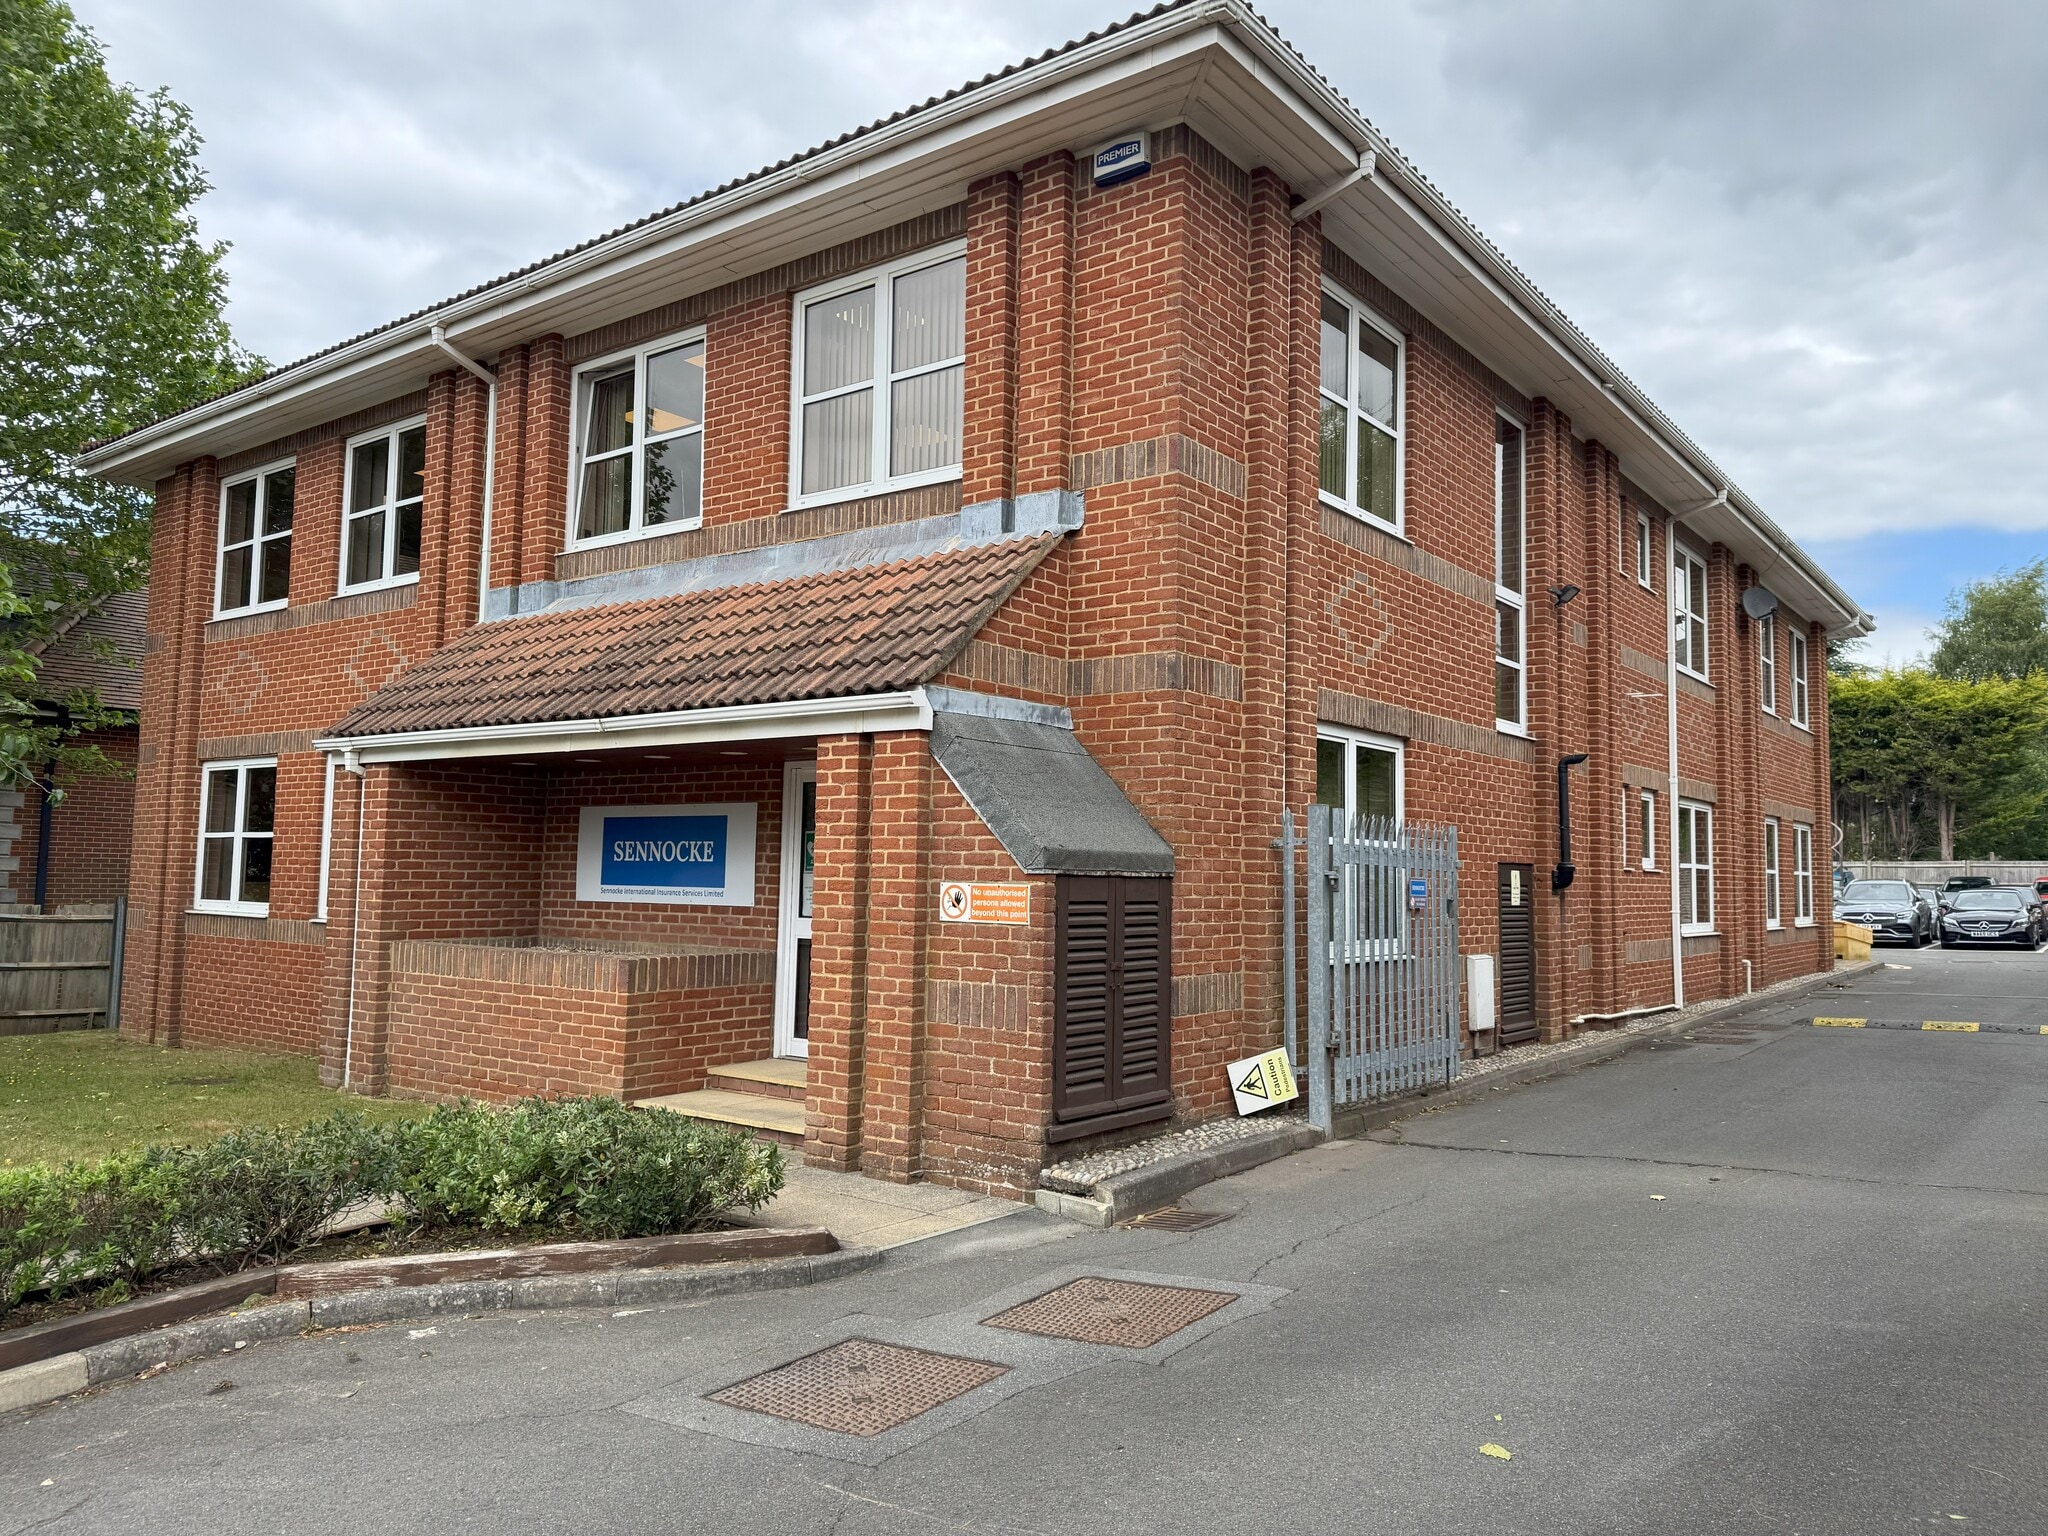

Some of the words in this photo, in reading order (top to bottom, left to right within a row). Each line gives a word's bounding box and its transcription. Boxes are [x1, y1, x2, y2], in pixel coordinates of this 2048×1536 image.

[1098, 143, 1139, 166] PREMIER
[613, 840, 714, 862] SENNOCKE
[656, 888, 681, 896] Insurance
[982, 888, 1026, 897] unauthorised
[971, 909, 995, 918] beyond
[996, 910, 1008, 918] this
[1009, 910, 1027, 919] point
[1267, 1058, 1282, 1096] Caution
